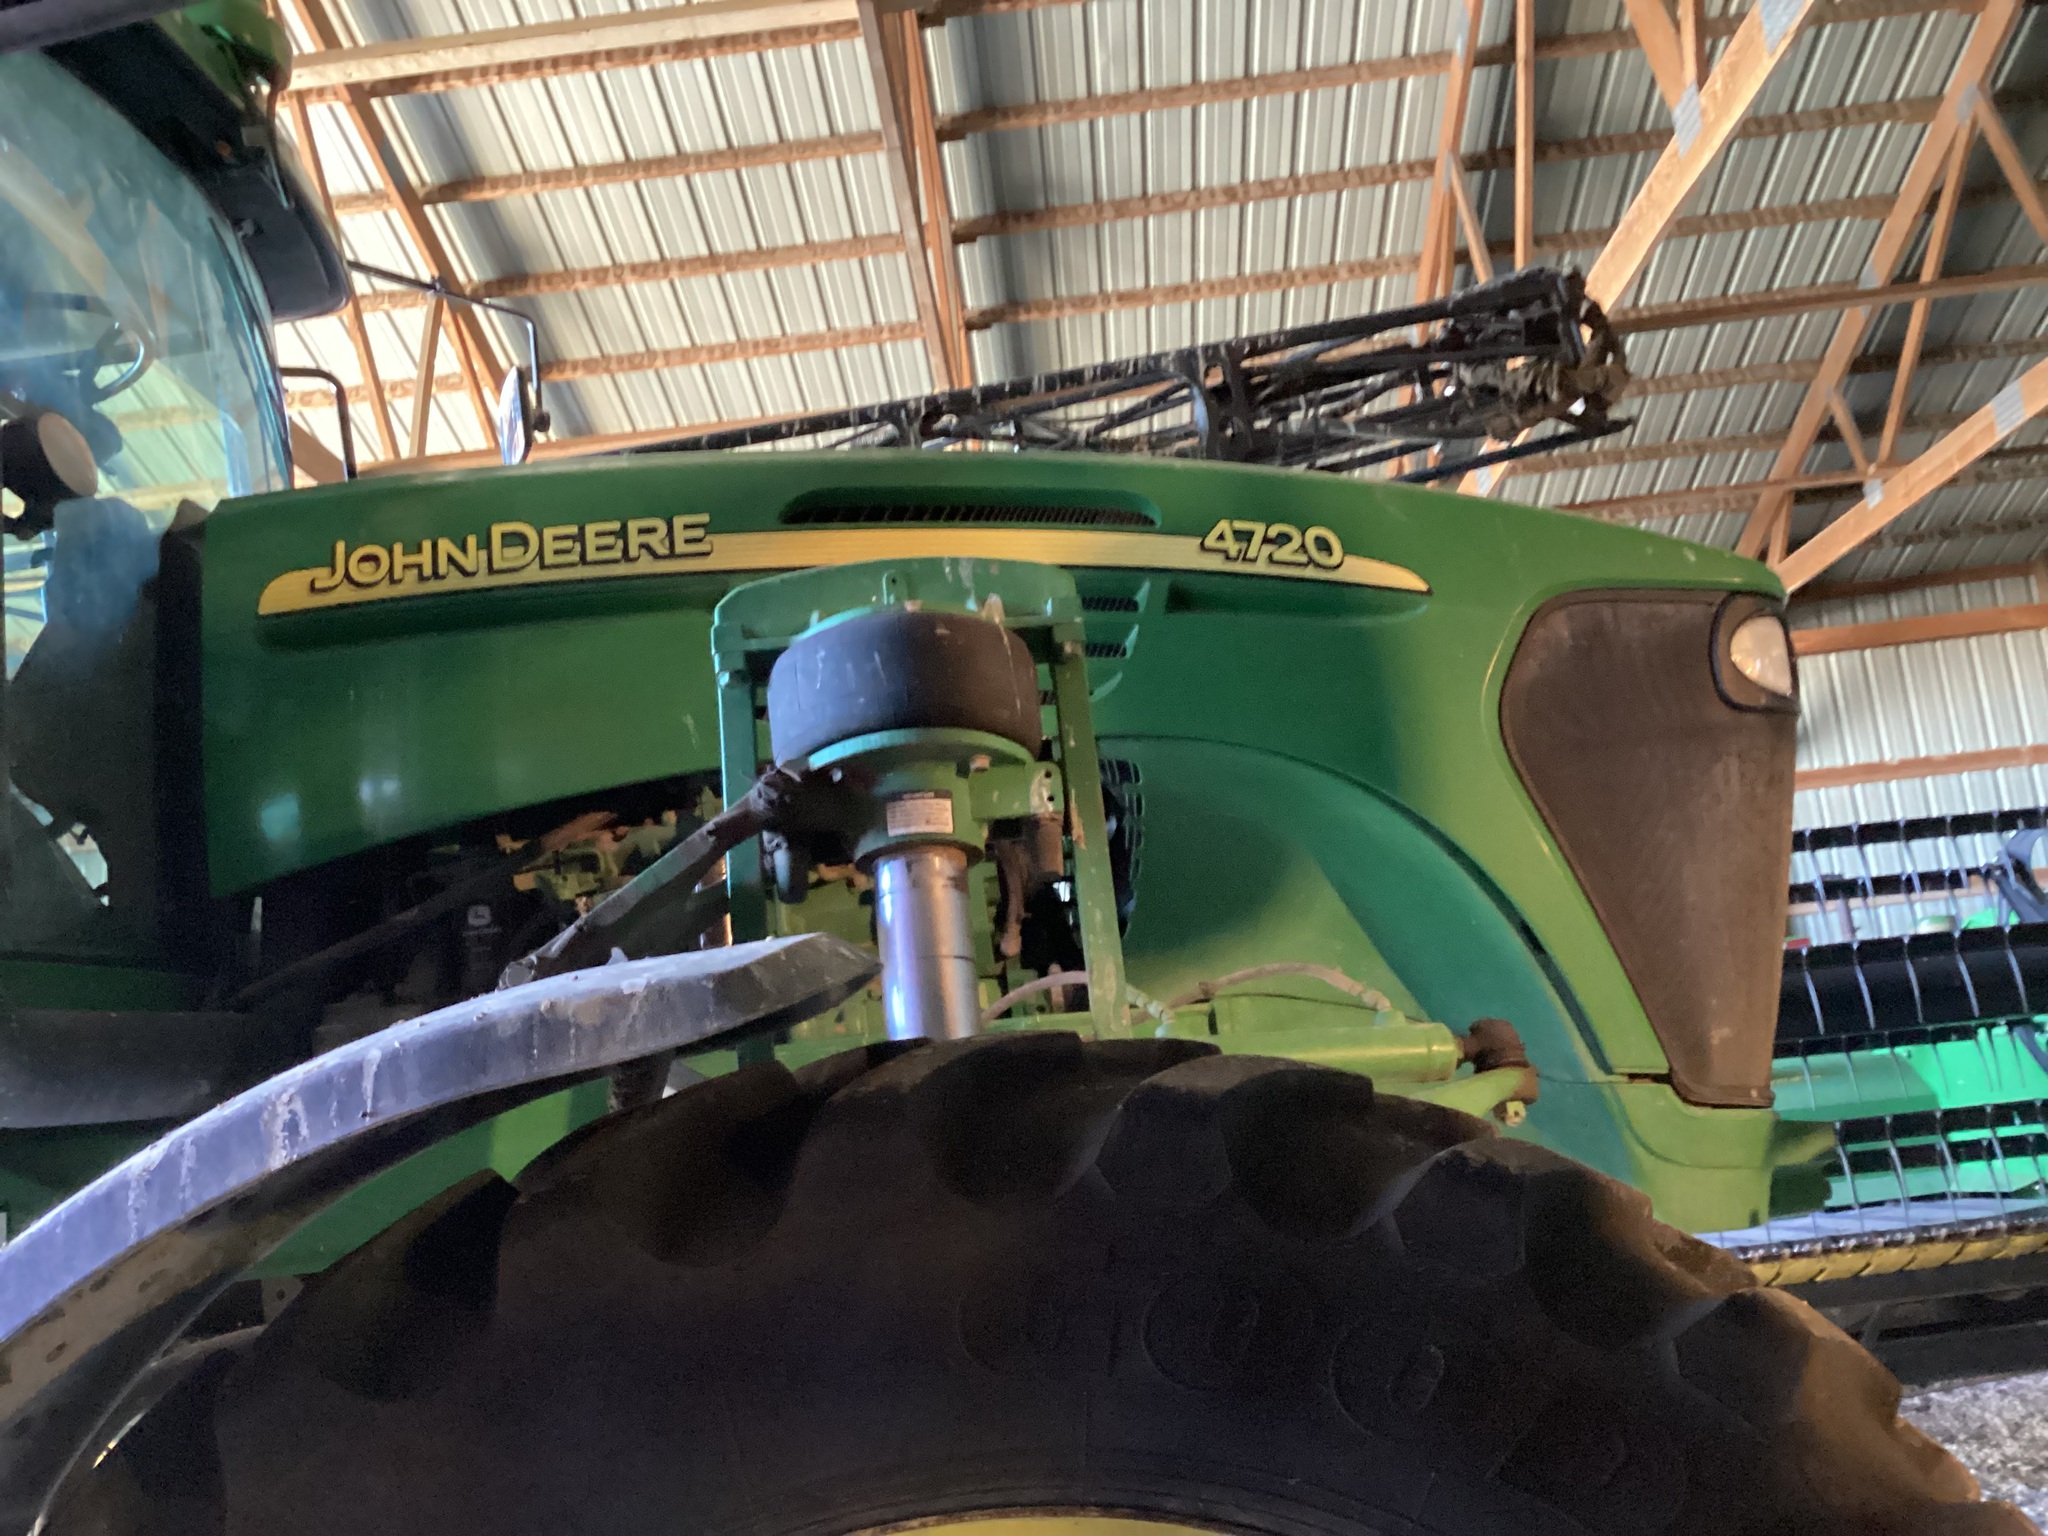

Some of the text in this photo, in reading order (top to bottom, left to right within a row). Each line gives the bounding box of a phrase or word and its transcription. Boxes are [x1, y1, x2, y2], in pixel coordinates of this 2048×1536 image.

[310, 512, 712, 593] JOHN DEERE
[1200, 518, 1344, 569] 4720
